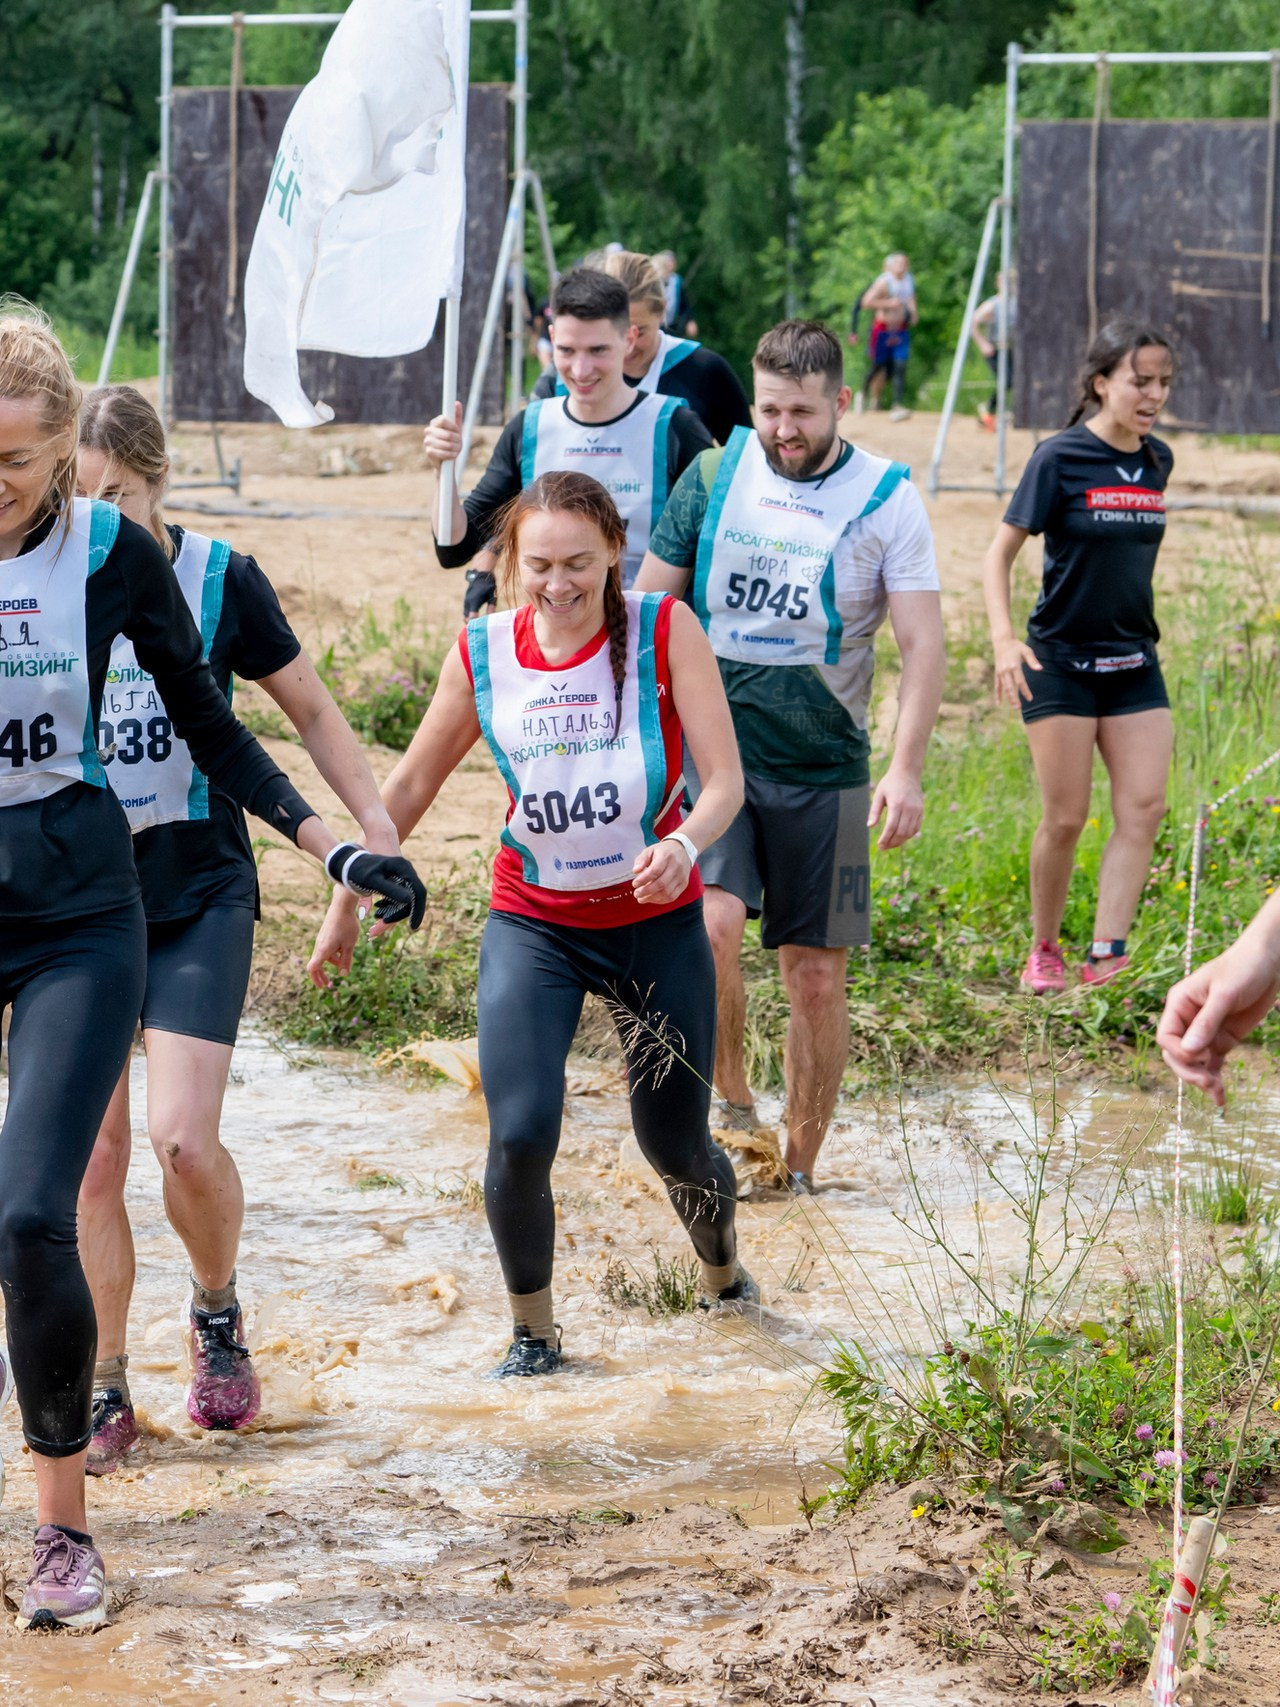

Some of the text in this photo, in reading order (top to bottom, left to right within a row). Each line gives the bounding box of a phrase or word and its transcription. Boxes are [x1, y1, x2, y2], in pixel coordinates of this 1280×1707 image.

[590, 446, 623, 454] ГЕРОЕВ
[759, 496, 825, 516] ГОНКА ГЕРОЕВ
[1093, 510, 1166, 524] ГОНКА ГЕРО
[748, 552, 789, 577] ЮРА
[725, 572, 809, 620] 5045
[742, 634, 796, 646] ГАЗПРОМБАНК
[7, 651, 75, 660] ОБЩЕСТВО
[524, 693, 598, 710] ГОНКА ГЕРОЕВ
[522, 711, 615, 737] НАТАЛЬЯ
[510, 735, 630, 765] РОСАГРОЛИЗИНГ
[120, 793, 157, 808] РОМБАНК
[522, 781, 621, 835] 5043
[565, 852, 624, 870] ГАЗПРОМБАНК
